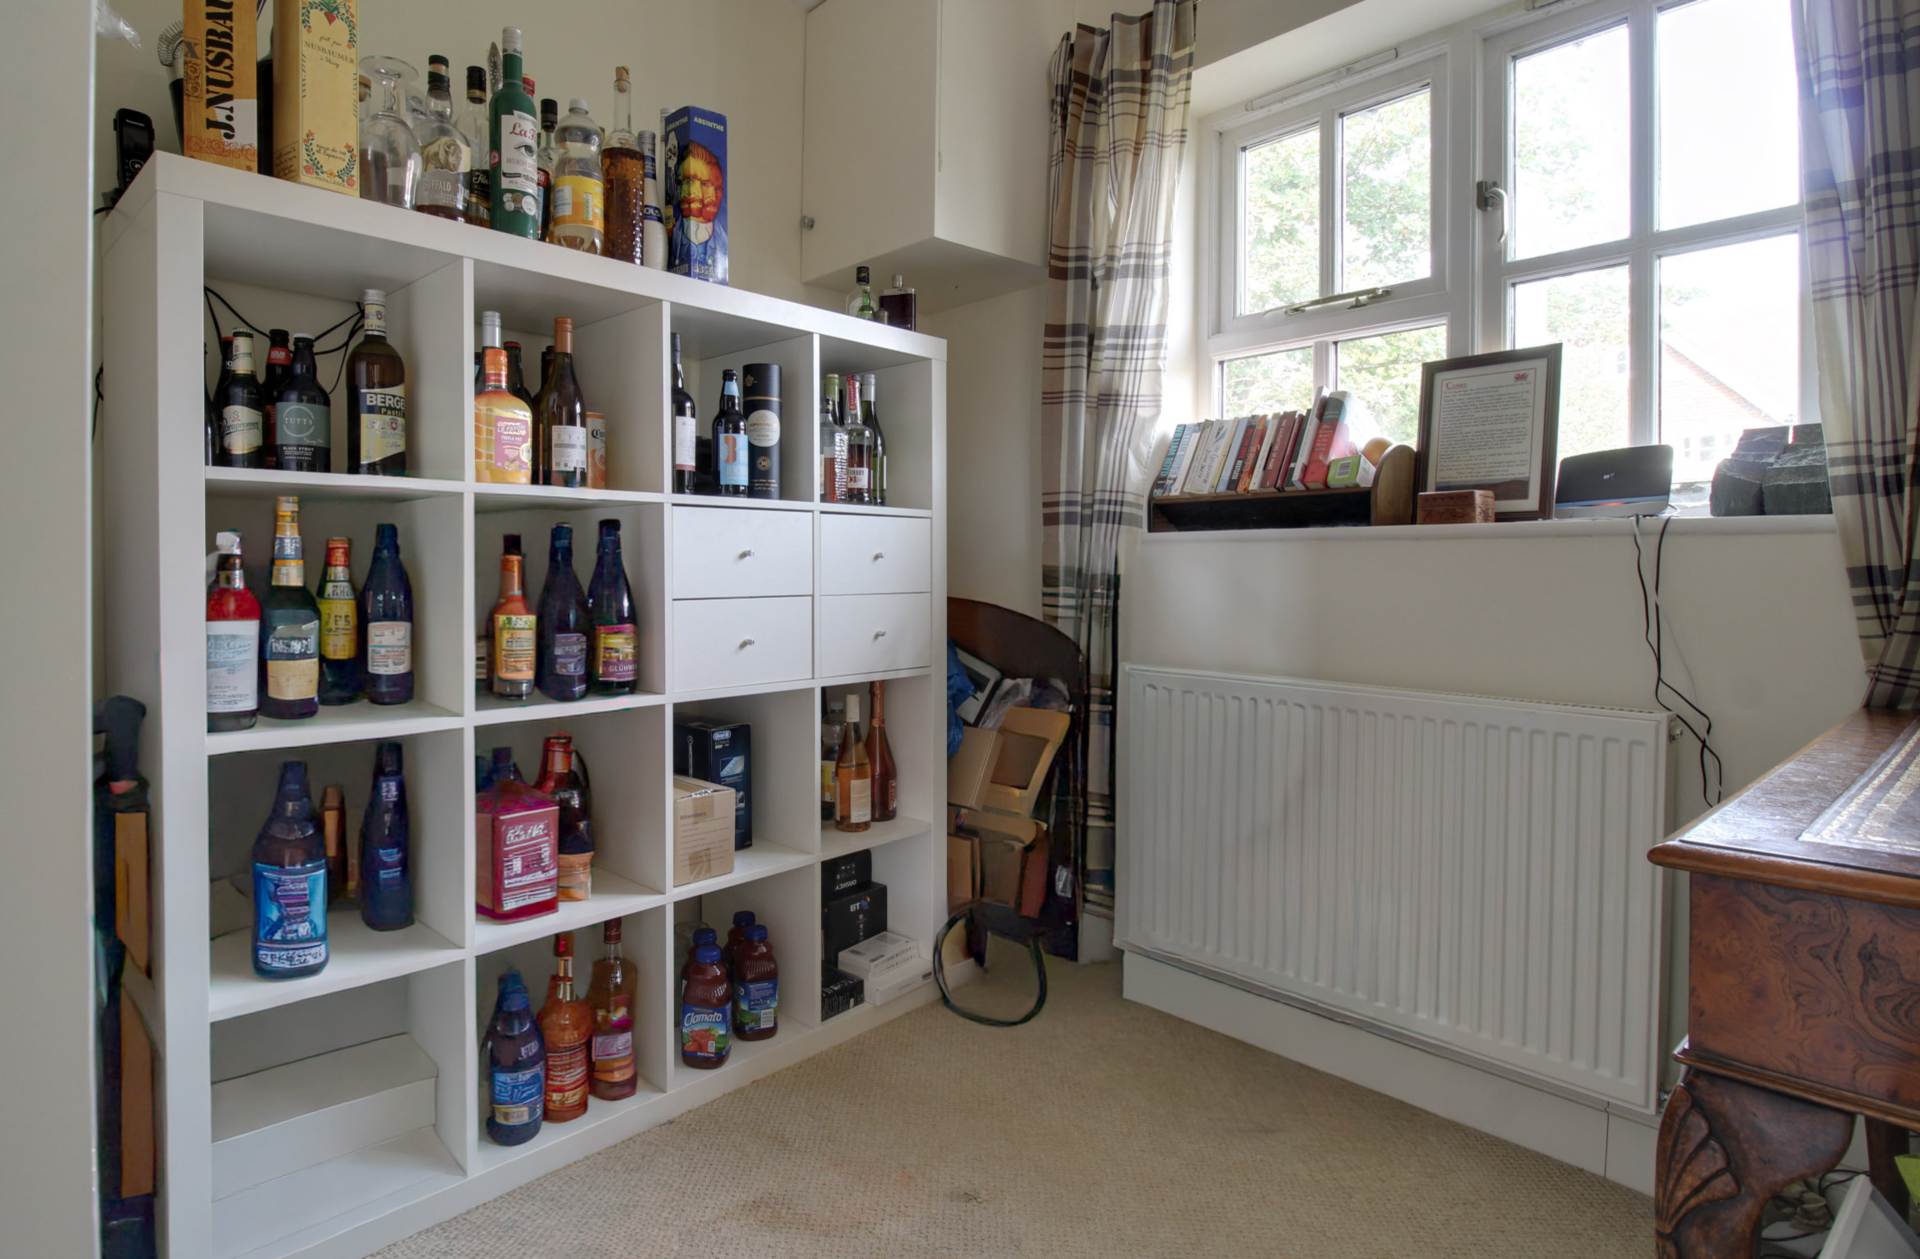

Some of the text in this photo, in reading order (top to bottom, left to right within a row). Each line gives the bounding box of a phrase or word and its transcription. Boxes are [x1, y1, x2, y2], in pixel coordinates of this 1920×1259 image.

[693, 116, 725, 133] ABSINTHE
[366, 393, 406, 410] BERGE
[381, 407, 405, 417] Pasti
[683, 1012, 724, 1026] Clamato
